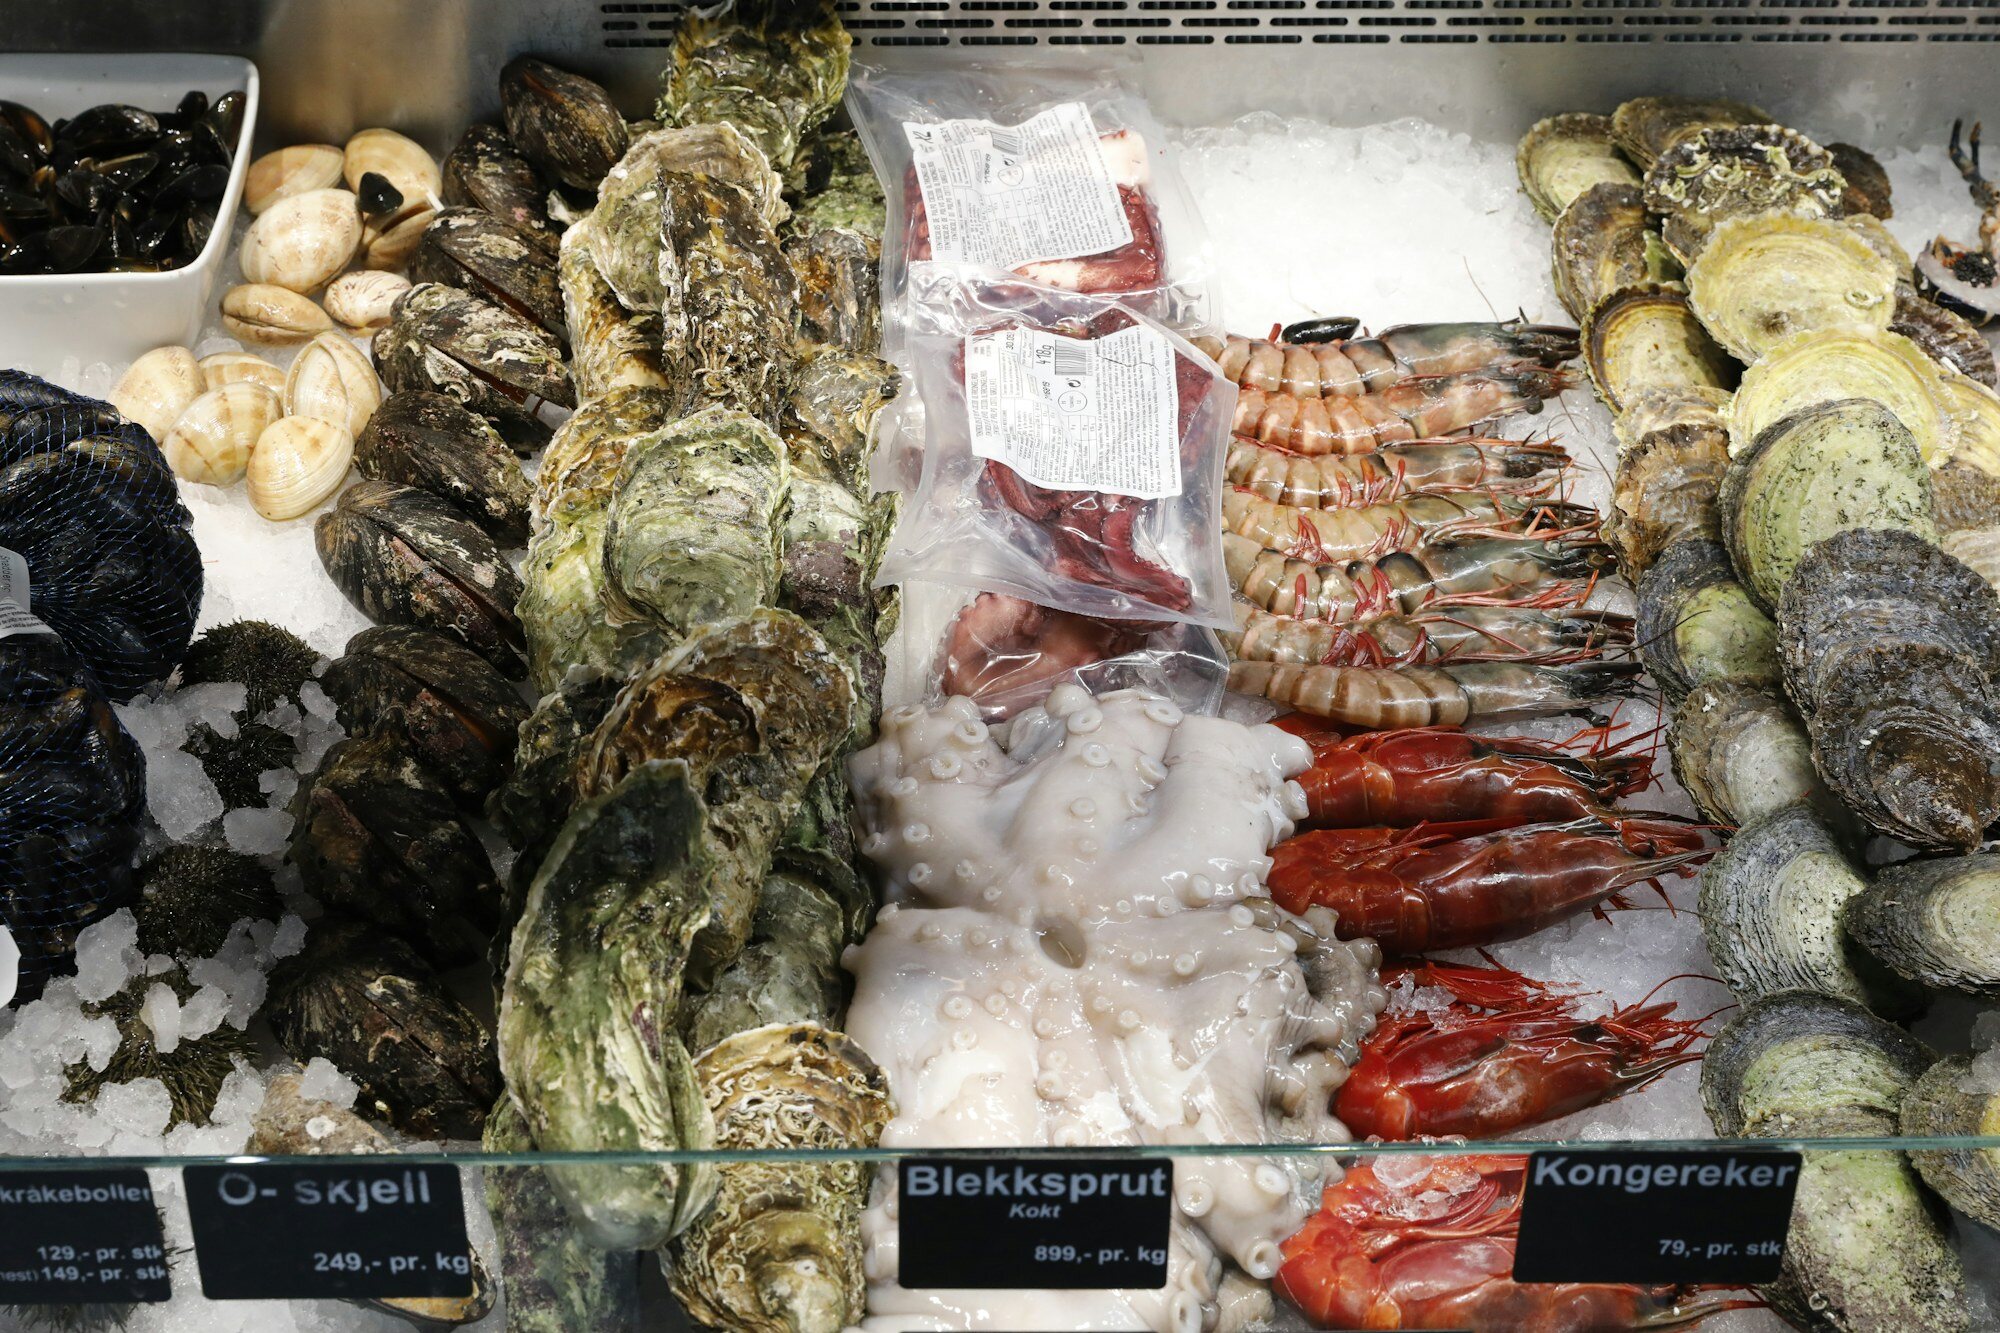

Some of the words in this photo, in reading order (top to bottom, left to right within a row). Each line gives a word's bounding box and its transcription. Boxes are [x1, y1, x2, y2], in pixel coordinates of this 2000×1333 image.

[906, 1165, 1167, 1204] Blekksprut
[1533, 1155, 1796, 1194] Kongereker
[1008, 1202, 1062, 1219] Kokt
[37, 1245, 91, 1262] 129,-
[95, 1247, 126, 1264] pr.
[1034, 1245, 1092, 1264] 899,-
[1098, 1248, 1130, 1265] pr.
[1137, 1245, 1167, 1266] kg
[1658, 1239, 1701, 1260] 79,-
[1706, 1242, 1739, 1259] pr.
[1745, 1239, 1782, 1256] stk
[313, 1252, 382, 1274] 249,-
[388, 1255, 427, 1275] pr.
[435, 1251, 469, 1275] kg
[41, 1265, 94, 1283] 149,-
[99, 1267, 130, 1283] pr.
